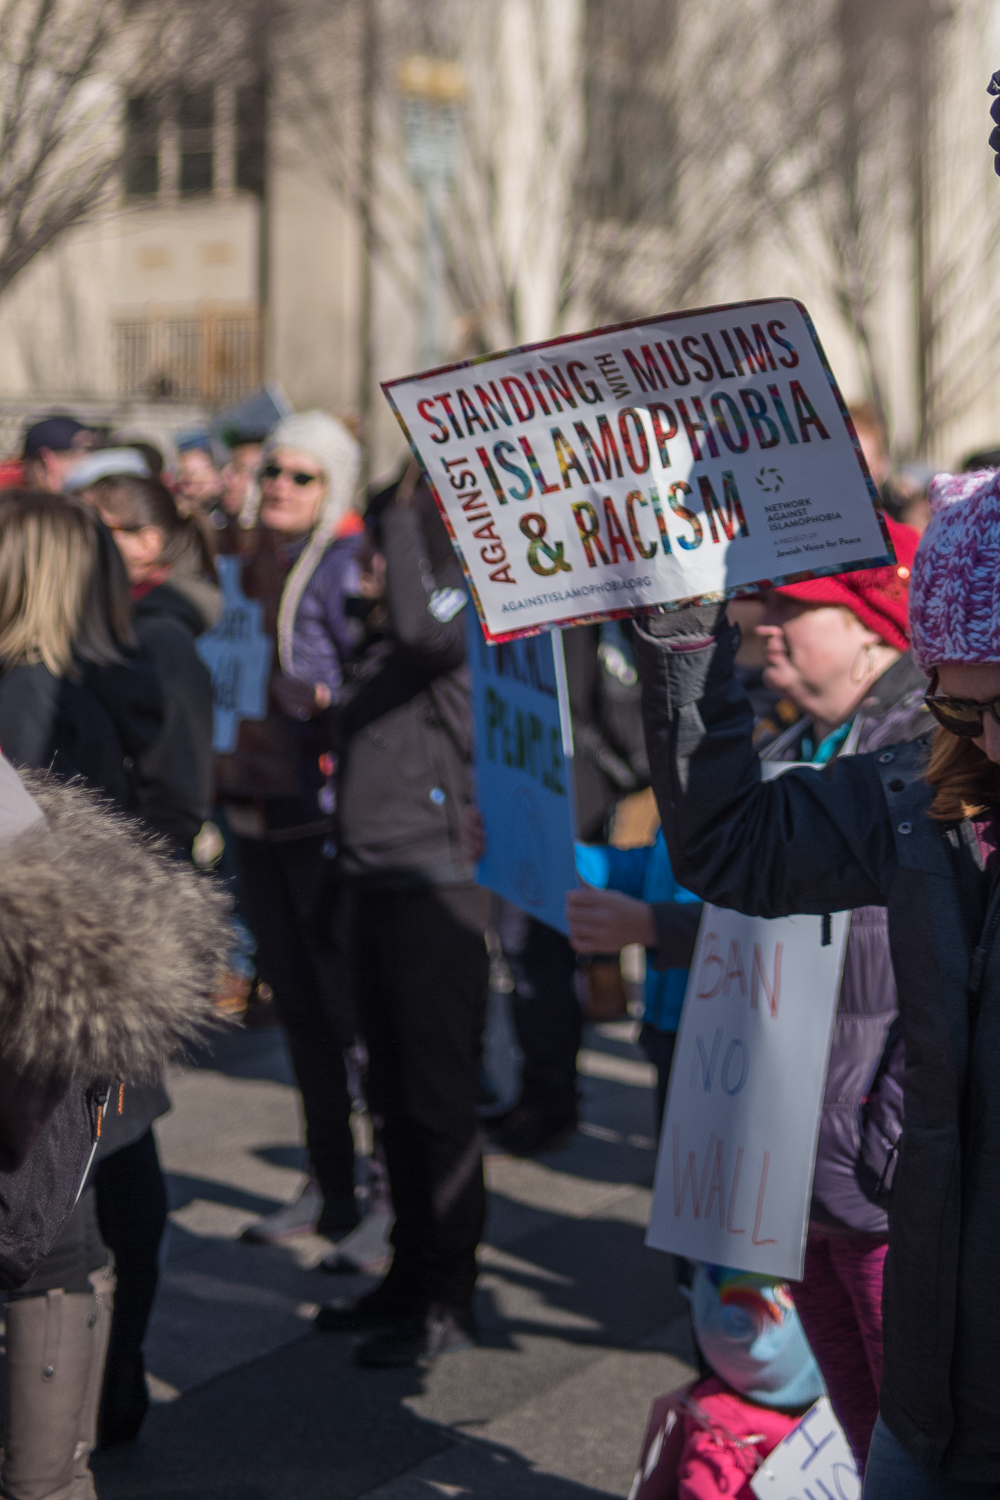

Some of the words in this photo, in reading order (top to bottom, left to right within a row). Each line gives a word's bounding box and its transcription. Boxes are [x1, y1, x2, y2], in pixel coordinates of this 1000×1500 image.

[416, 360, 605, 445] STANDING
[594, 352, 632, 400] WITH
[622, 319, 800, 393] MUSLIMS
[475, 379, 831, 506] ISLAMOPHOBIA
[440, 455, 517, 585] AGAINST
[518, 512, 573, 577] &
[571, 469, 751, 569] RACISM
[764, 498, 812, 513] NETWORK
[767, 508, 808, 522] AGAINST
[769, 512, 843, 532] ISLAMOPHOBIA
[776, 547, 802, 558] Jewish
[802, 542, 825, 552] Voice
[825, 539, 838, 548] for
[838, 537, 862, 545] Peace
[696, 932, 784, 1020] BAN
[689, 1027, 750, 1096] NO
[671, 1122, 779, 1246] WALL
